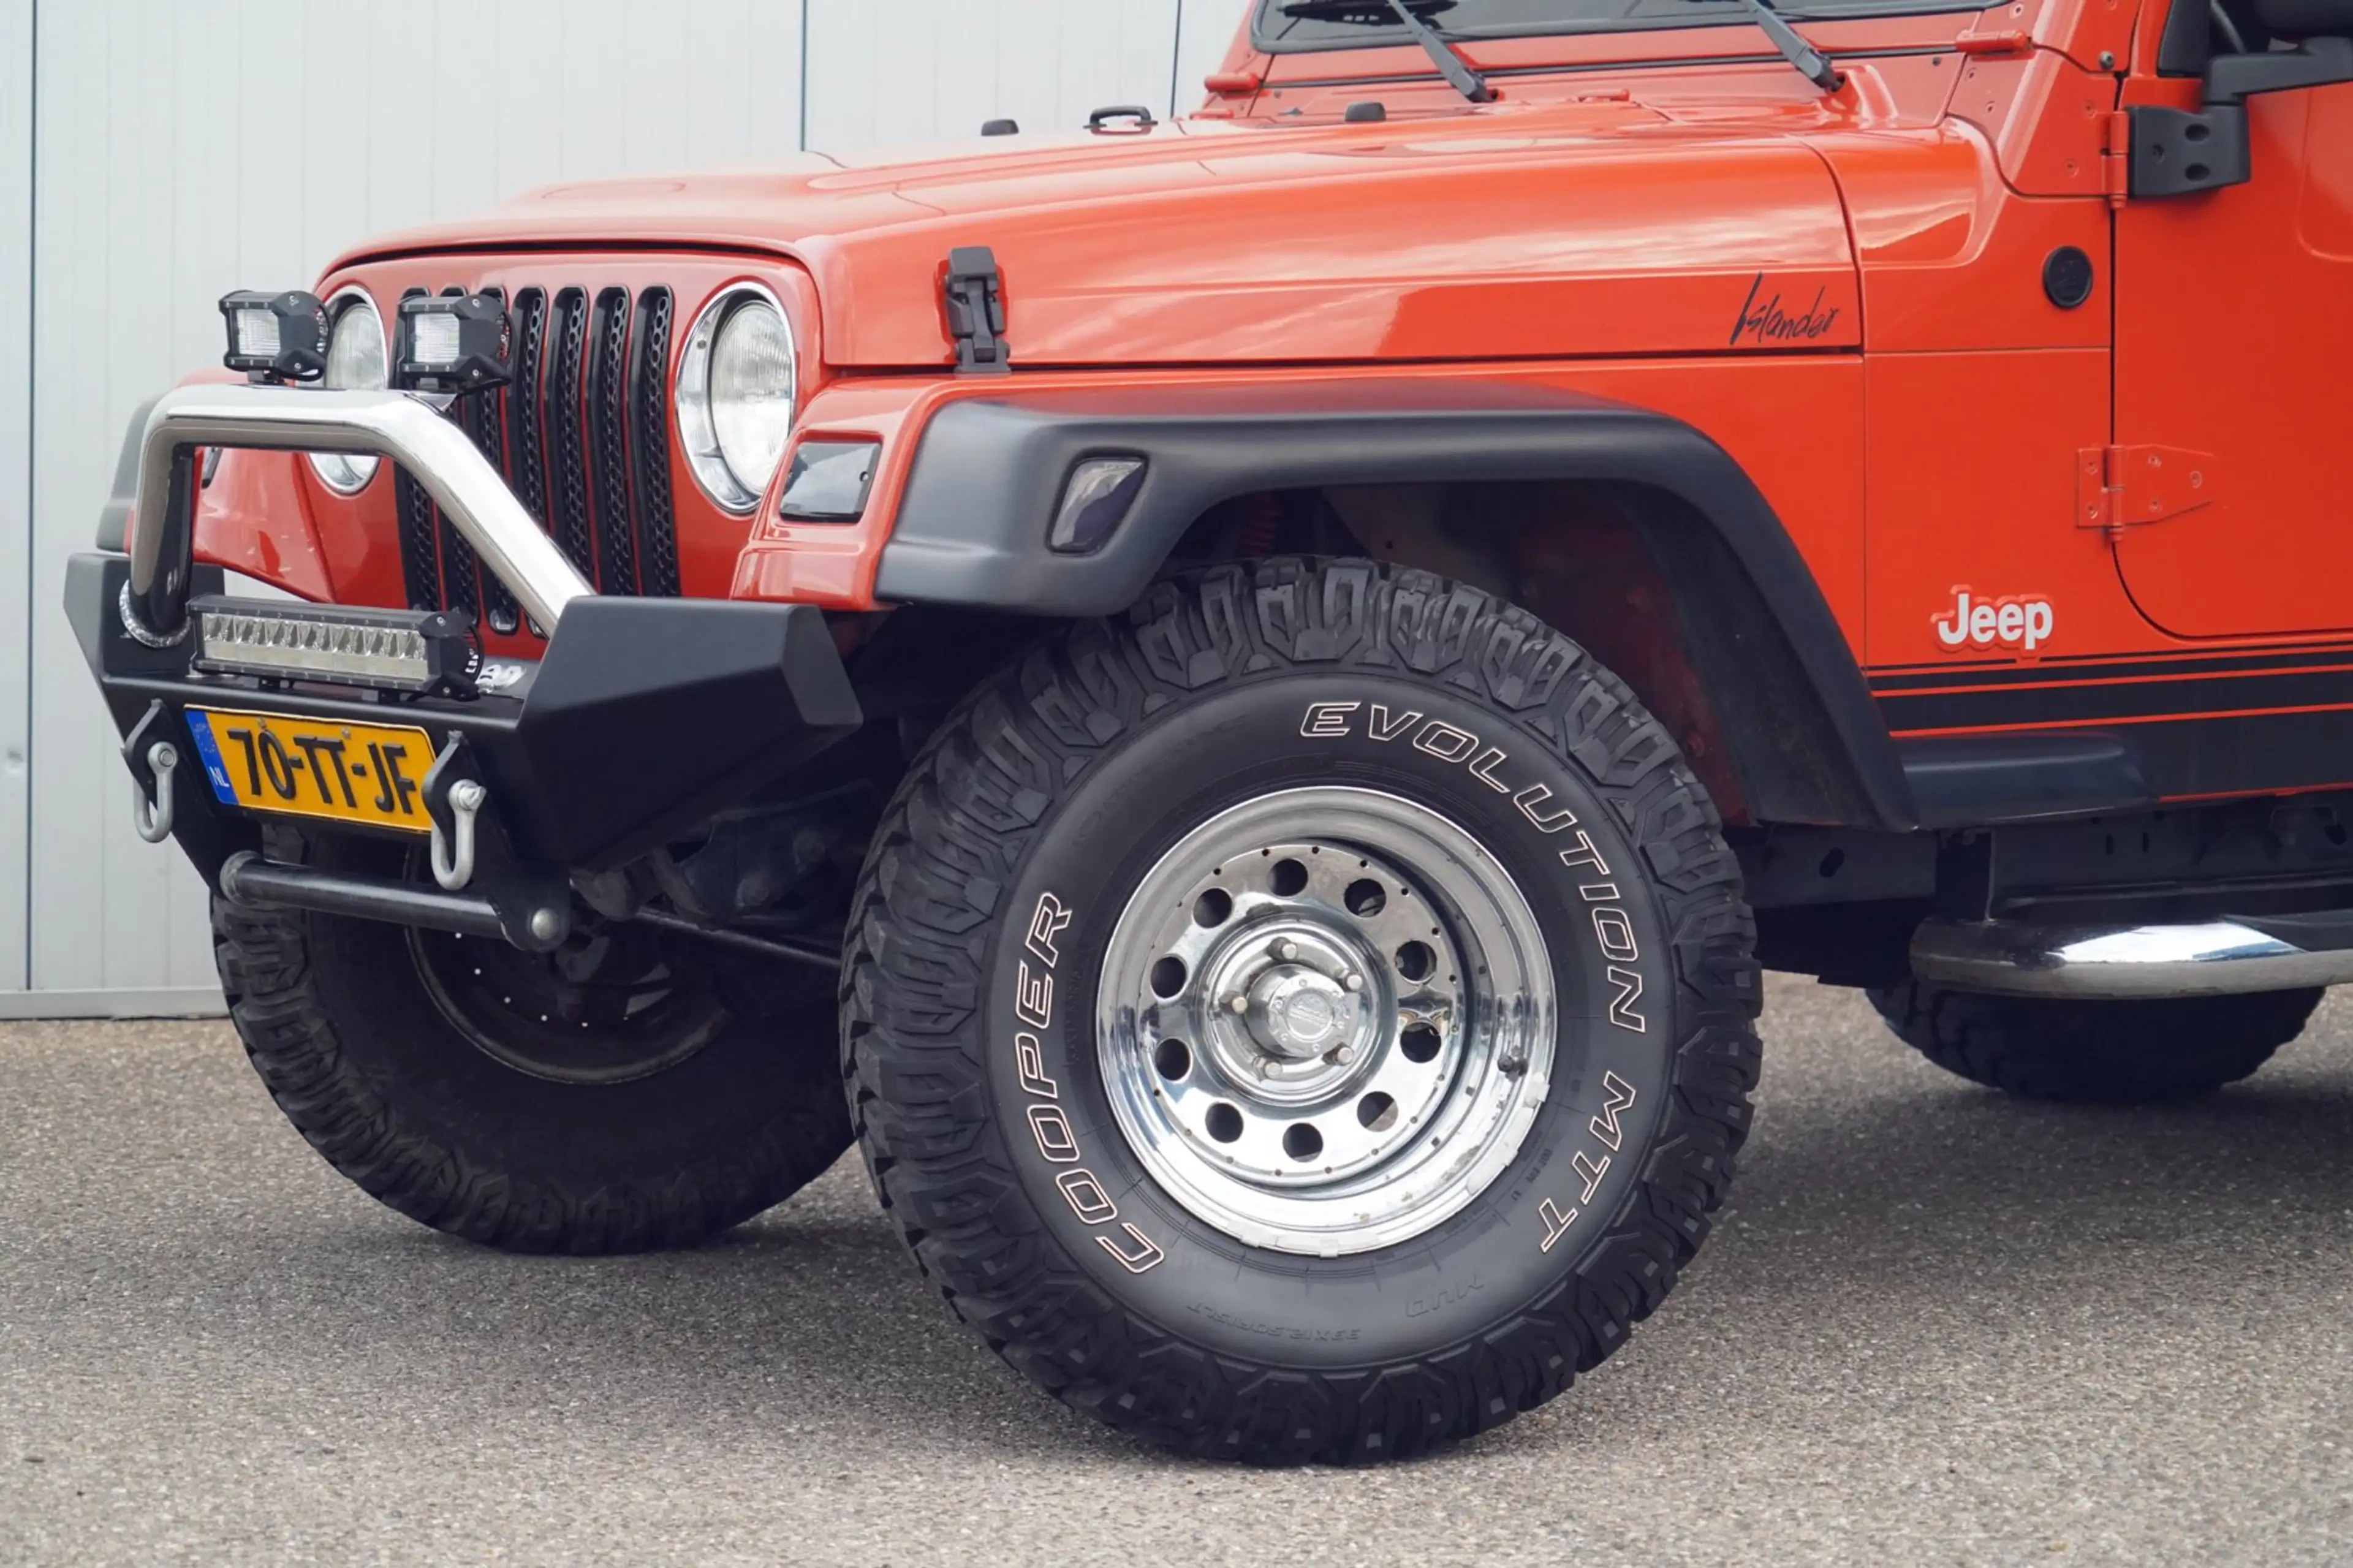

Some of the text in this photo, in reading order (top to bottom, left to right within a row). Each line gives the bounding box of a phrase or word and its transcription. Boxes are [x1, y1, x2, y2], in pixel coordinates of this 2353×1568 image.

[1729, 271, 1840, 345] Islander
[1938, 593, 2053, 650] Jeep
[209, 766, 230, 787] NL
[227, 728, 417, 815] 70-TT-JF
[1014, 700, 1646, 1274] COOPER EVOLUTION MTT
